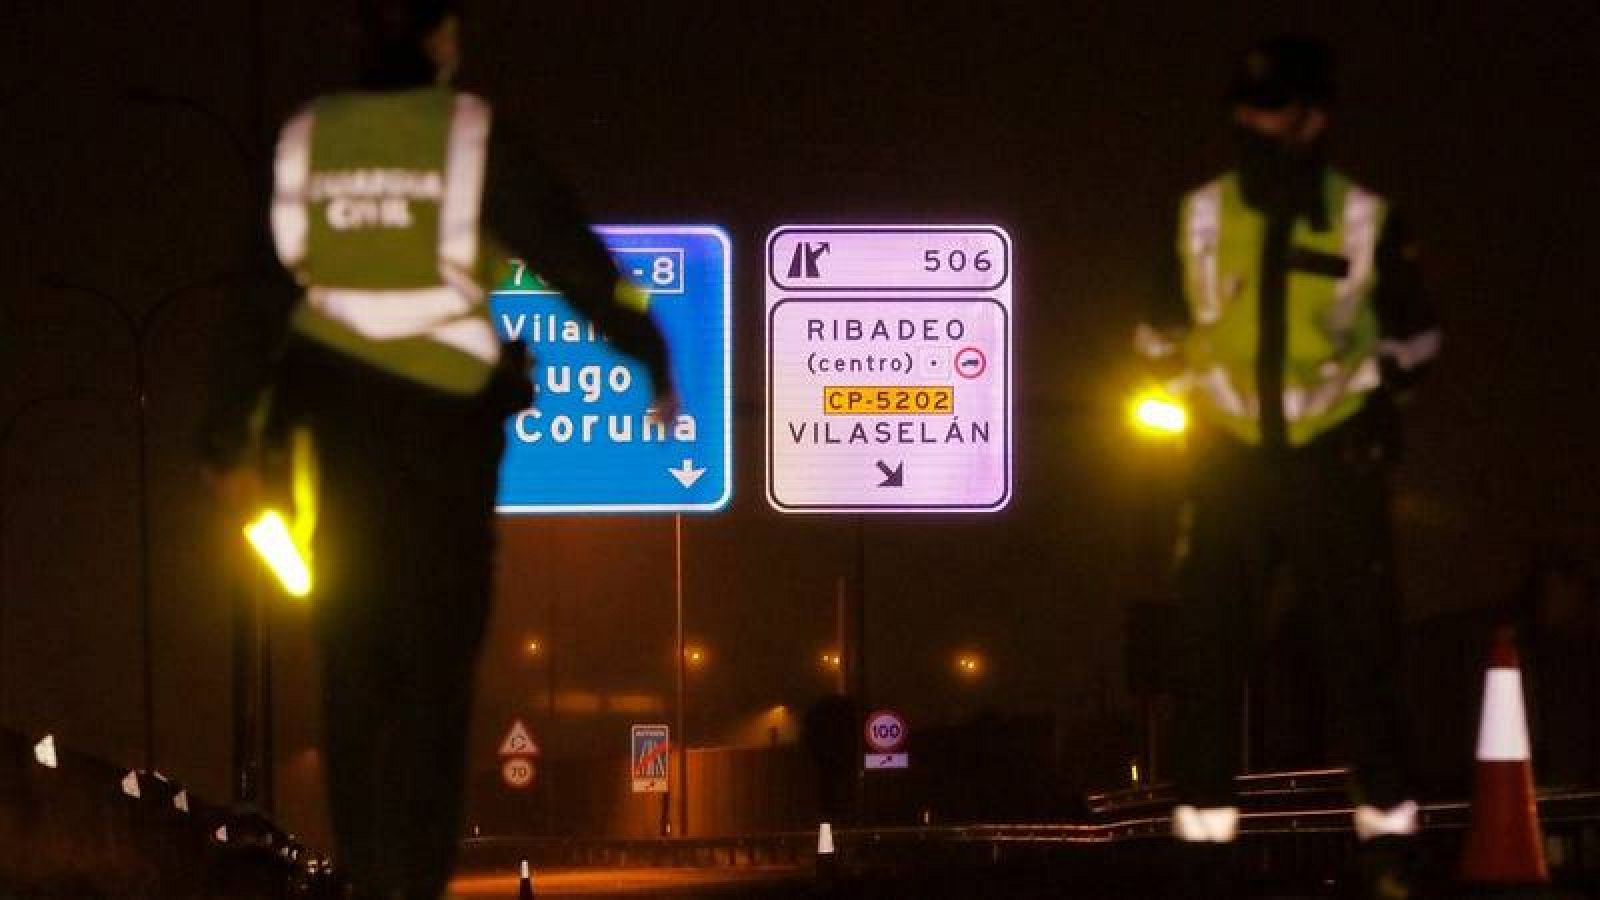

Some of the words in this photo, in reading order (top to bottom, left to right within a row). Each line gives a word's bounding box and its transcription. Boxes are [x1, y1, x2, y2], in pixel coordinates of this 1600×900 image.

[923, 249, 992, 273] 506
[806, 318, 966, 342] RIBADEO
[806, 352, 914, 375] (centro)
[533, 364, 633, 404] ugo
[827, 391, 950, 411] CP-5202
[514, 407, 698, 443] Coruña
[787, 415, 990, 444] VILASELÁN
[873, 723, 901, 739] 100
[511, 767, 527, 779] 70
